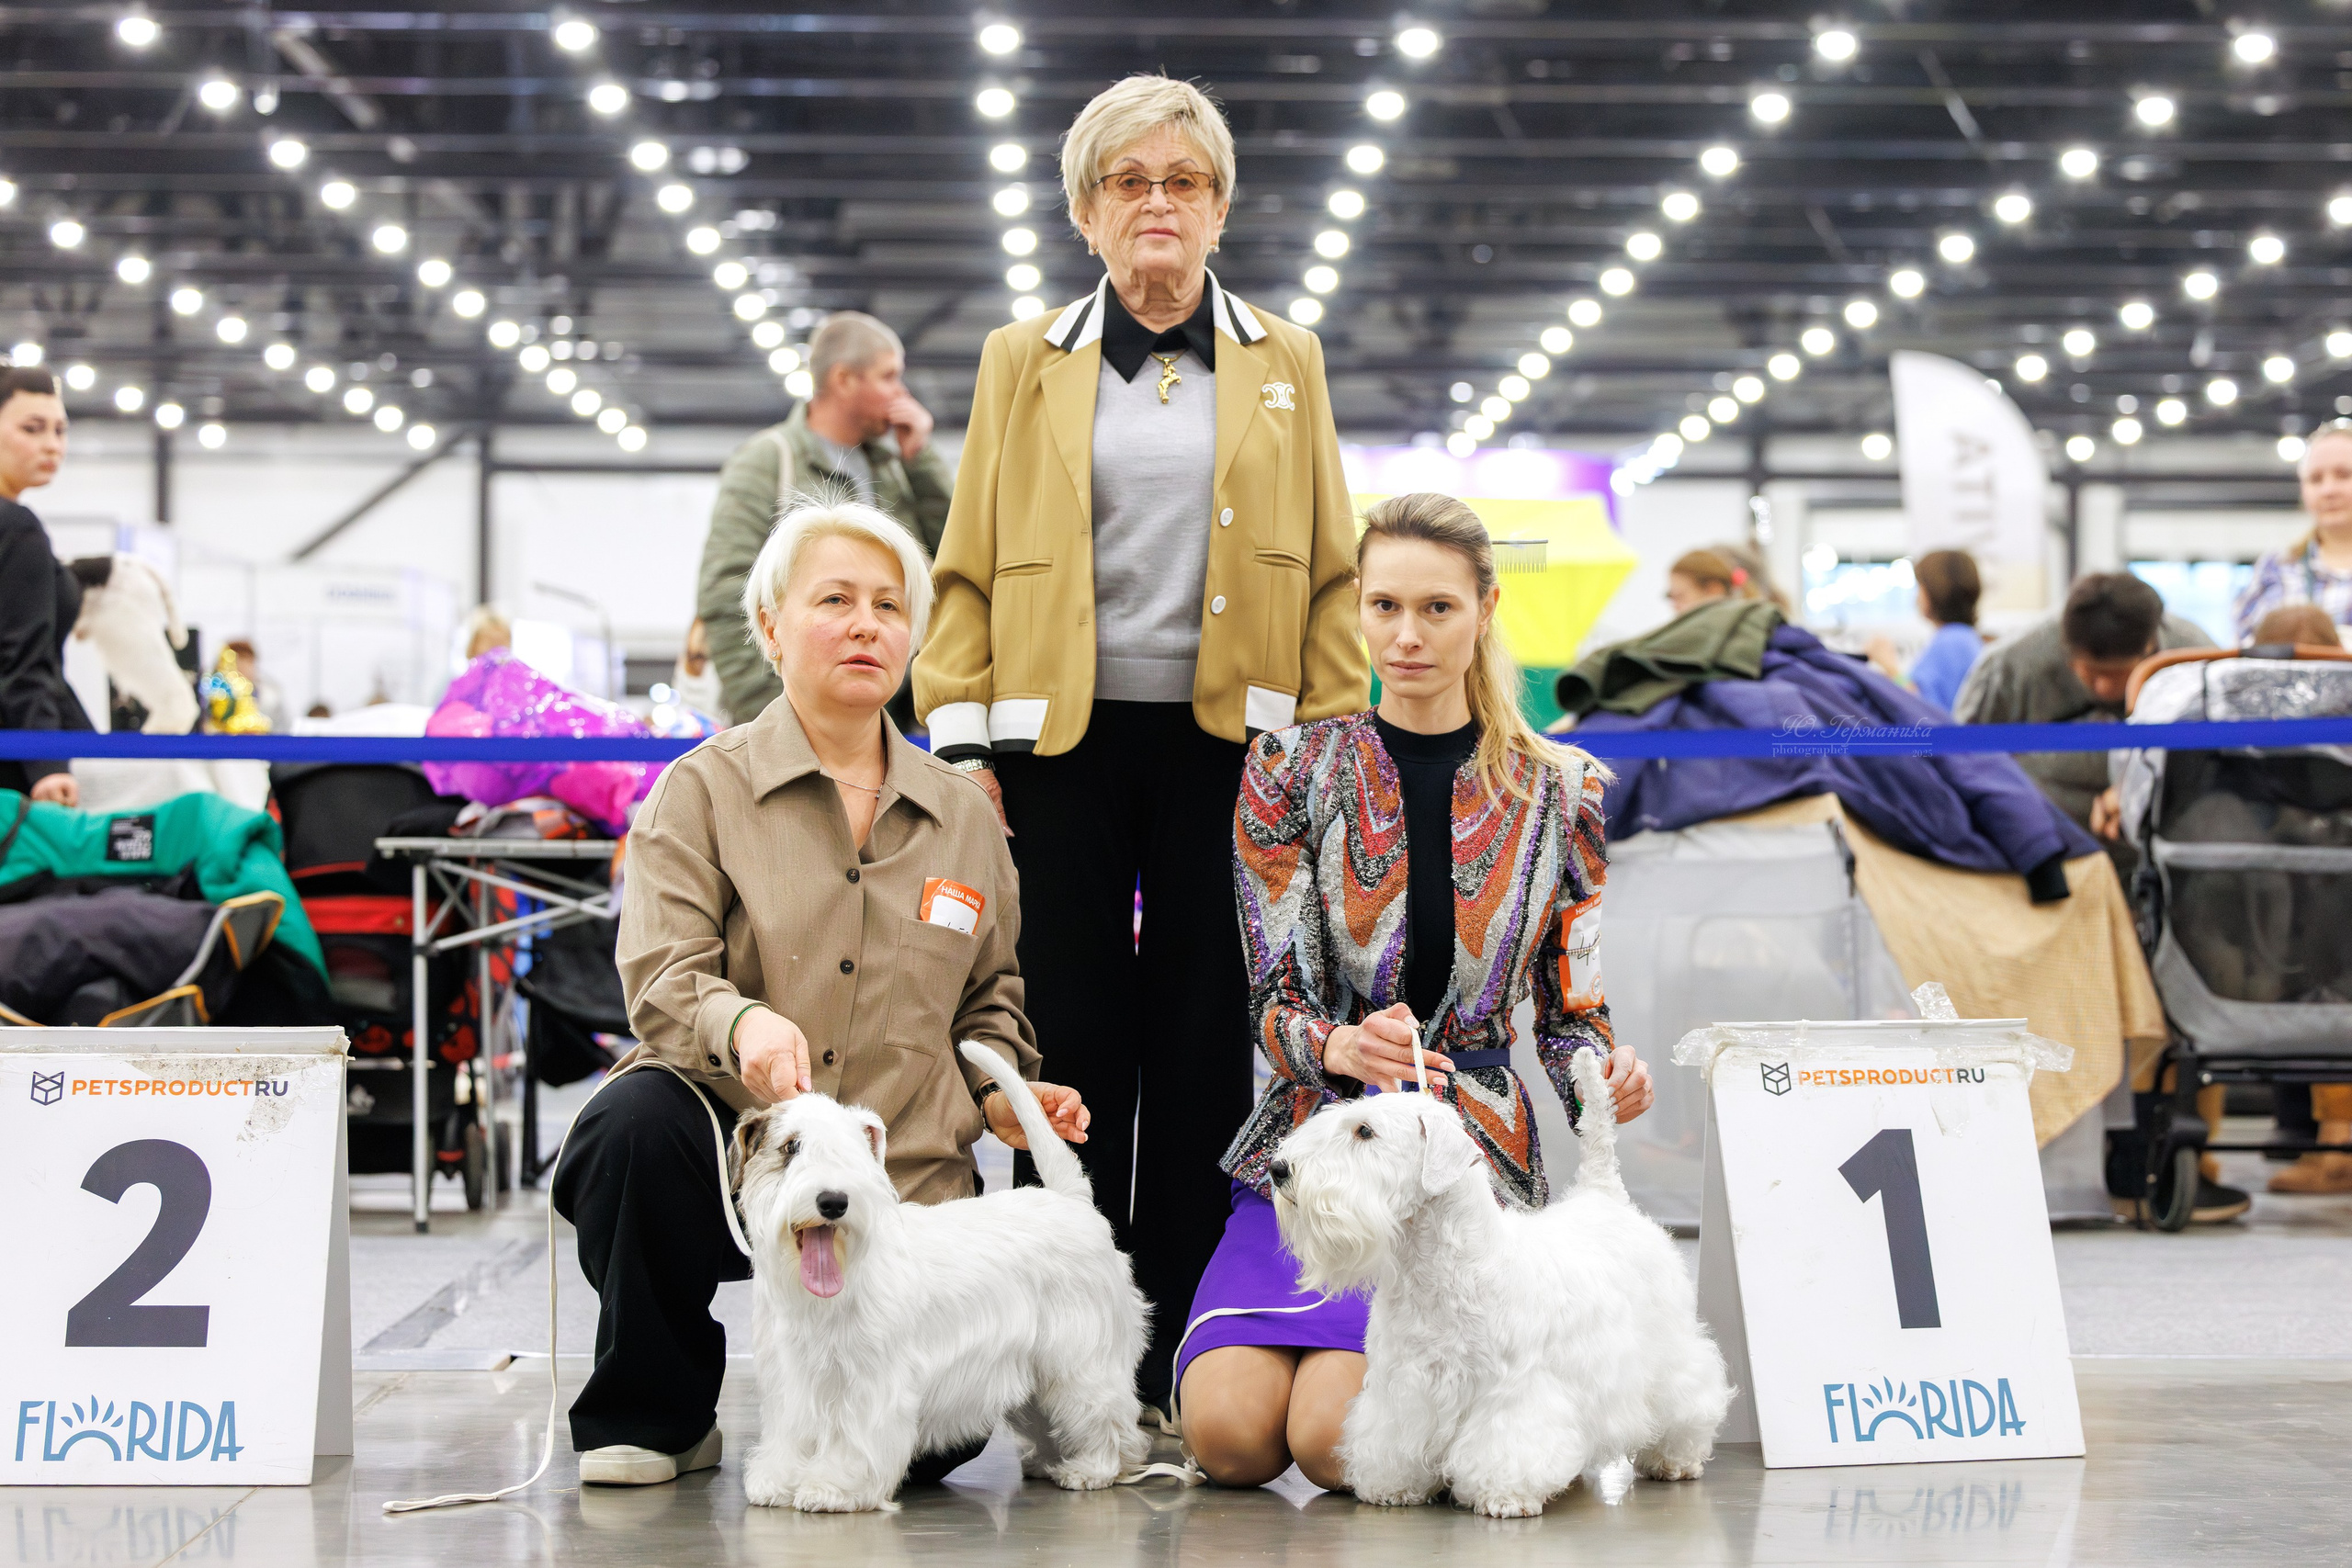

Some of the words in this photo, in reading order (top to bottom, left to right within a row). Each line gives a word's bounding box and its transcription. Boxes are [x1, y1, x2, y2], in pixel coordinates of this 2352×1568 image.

[941, 886, 965, 900] НАША
[64, 1138, 212, 1348] 2
[1838, 1129, 1941, 1329] 1
[15, 1393, 245, 1461] FLORIDA
[1823, 1375, 2027, 1443] FLORIDA
